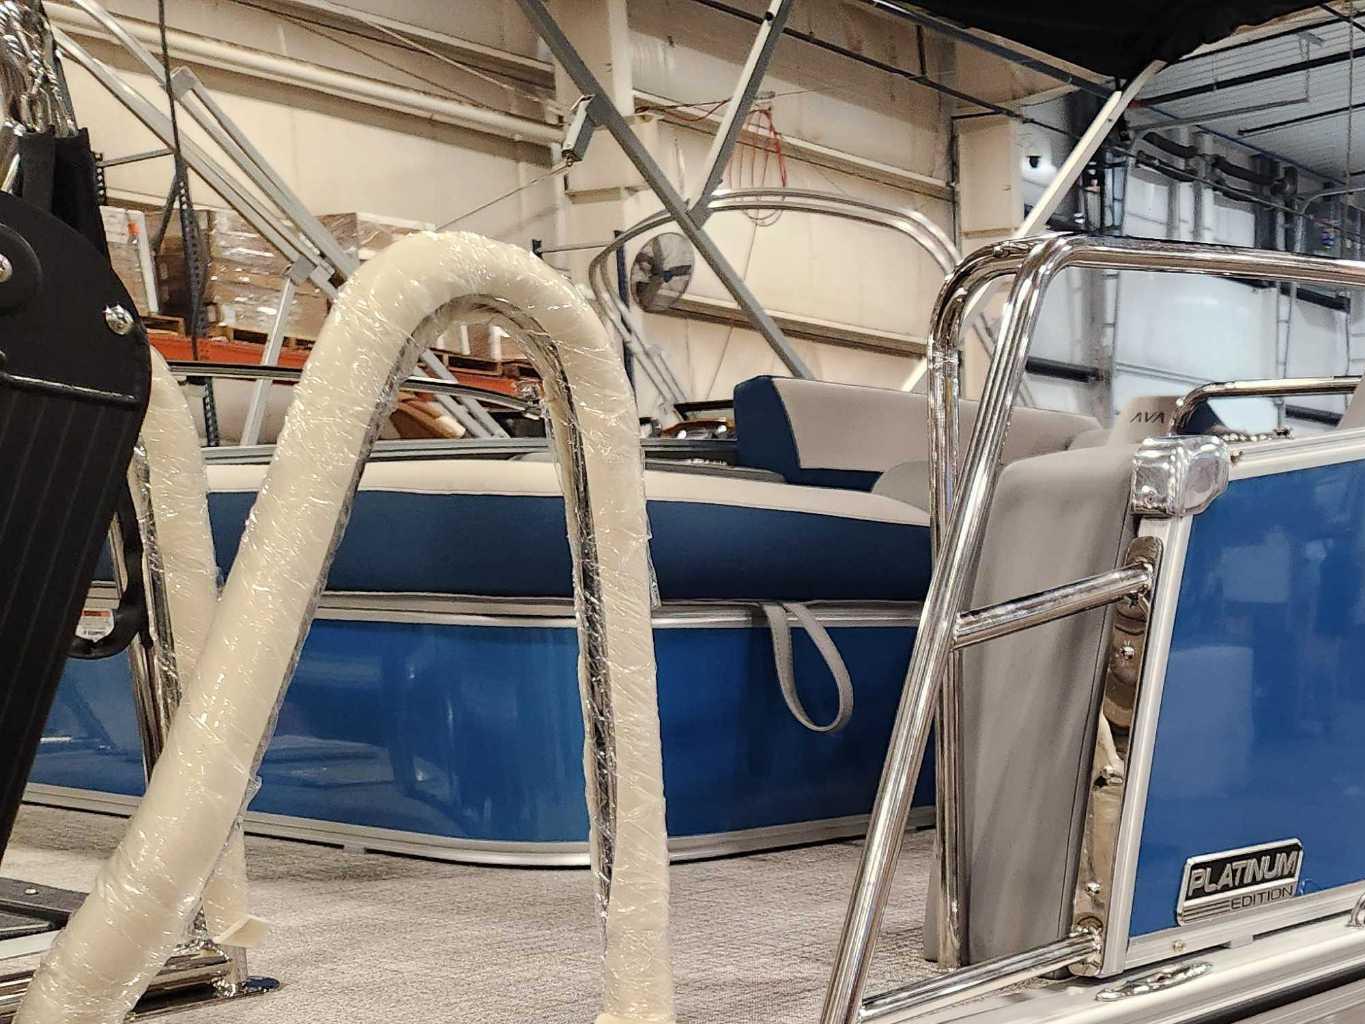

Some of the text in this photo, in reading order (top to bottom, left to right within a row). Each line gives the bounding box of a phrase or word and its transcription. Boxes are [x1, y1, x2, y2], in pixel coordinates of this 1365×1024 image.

[1130, 411, 1165, 424] AVA
[1188, 850, 1297, 896] PLATINUM
[1230, 886, 1294, 910] EDITION
